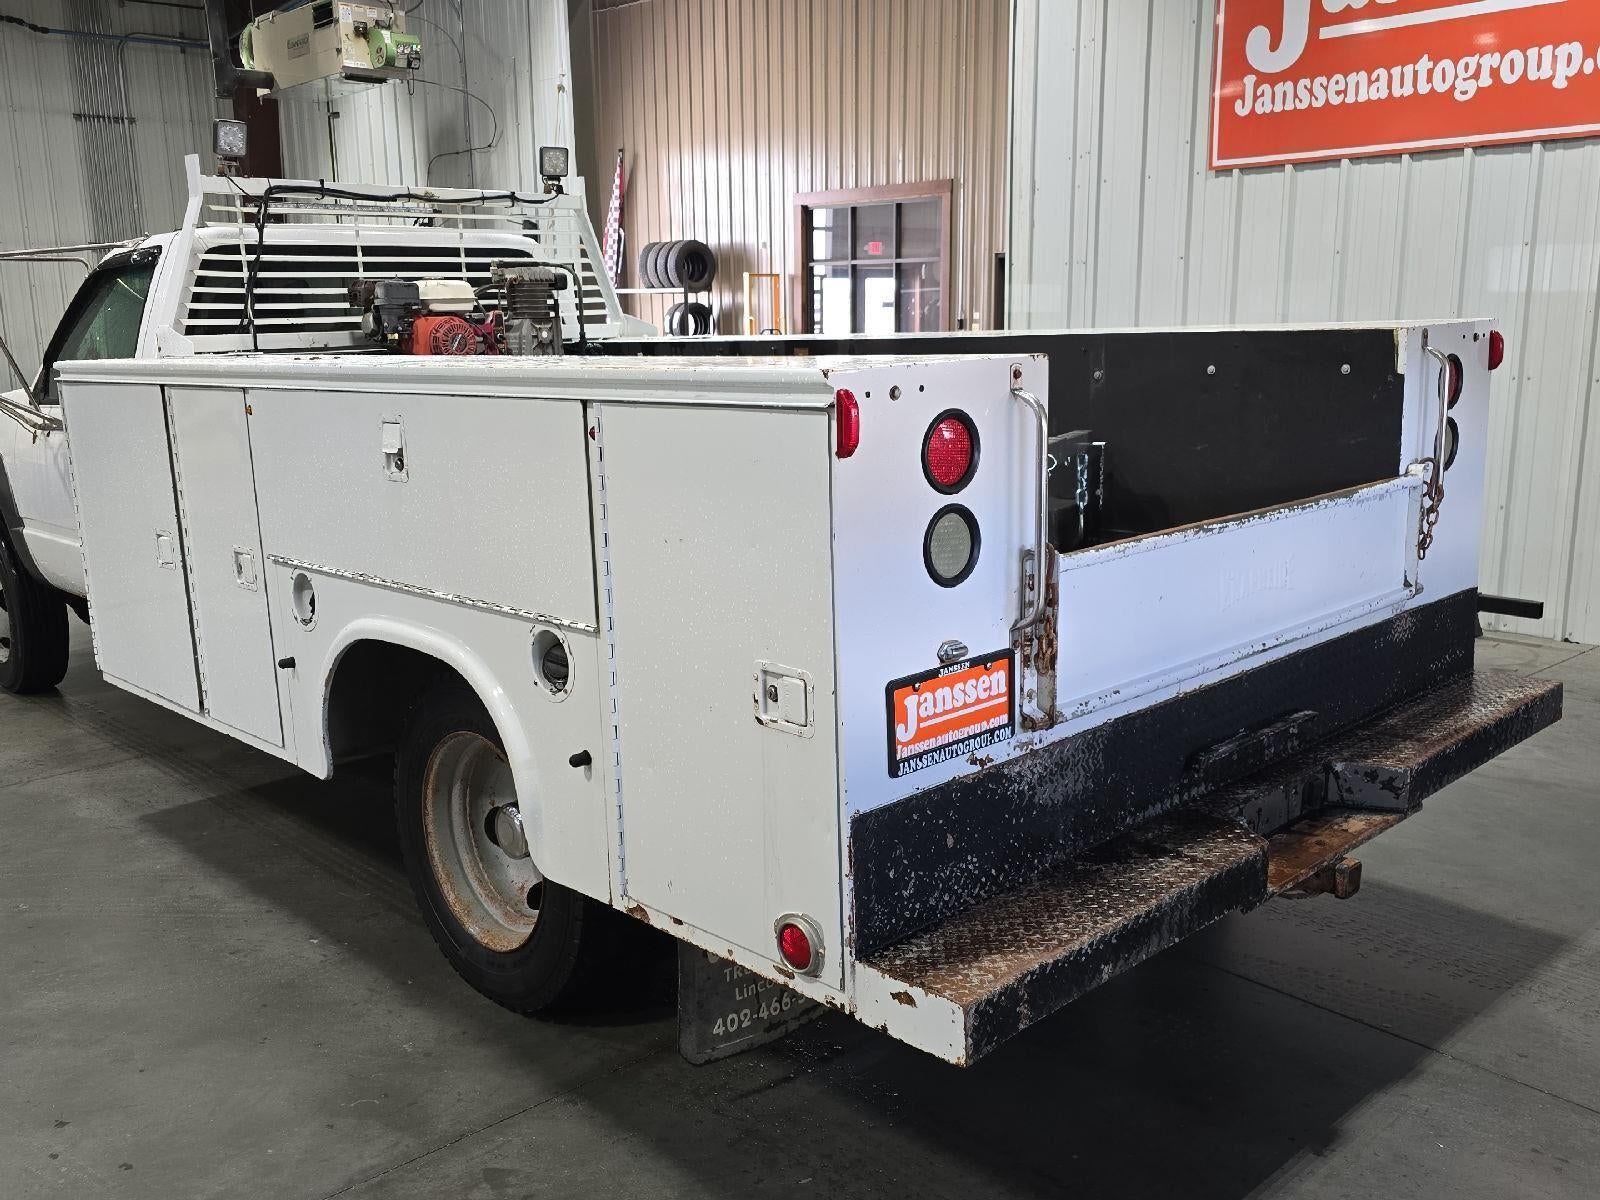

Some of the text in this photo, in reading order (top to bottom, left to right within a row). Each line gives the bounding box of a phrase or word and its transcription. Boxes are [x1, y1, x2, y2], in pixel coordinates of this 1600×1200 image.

[1234, 41, 1600, 117] Janssenautogroup.
[896, 669, 1007, 742] Janssen
[897, 726, 1012, 776] JANSSENAUTOGROUP.COM
